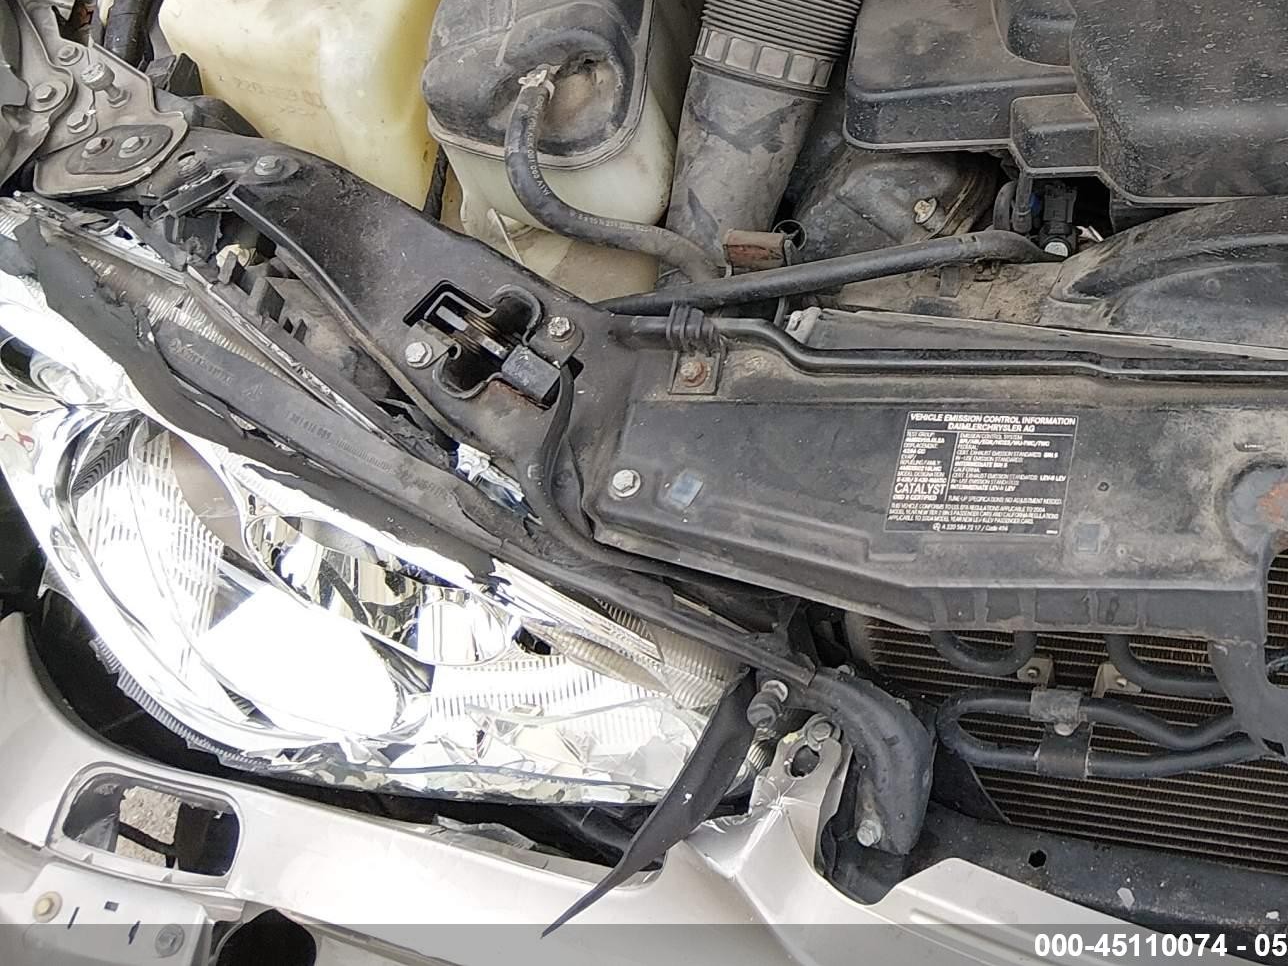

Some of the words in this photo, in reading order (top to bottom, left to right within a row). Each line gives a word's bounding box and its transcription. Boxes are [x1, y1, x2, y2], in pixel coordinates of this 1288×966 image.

[910, 413, 943, 422] VEHICLE
[944, 414, 982, 423] EMISSION
[983, 415, 1020, 424] CONTROL
[1022, 416, 1076, 426] INFORMATION
[947, 422, 1022, 432] DAIMLERCHRYSLER
[1023, 424, 1036, 432] AG
[894, 482, 947, 495] CATALYST
